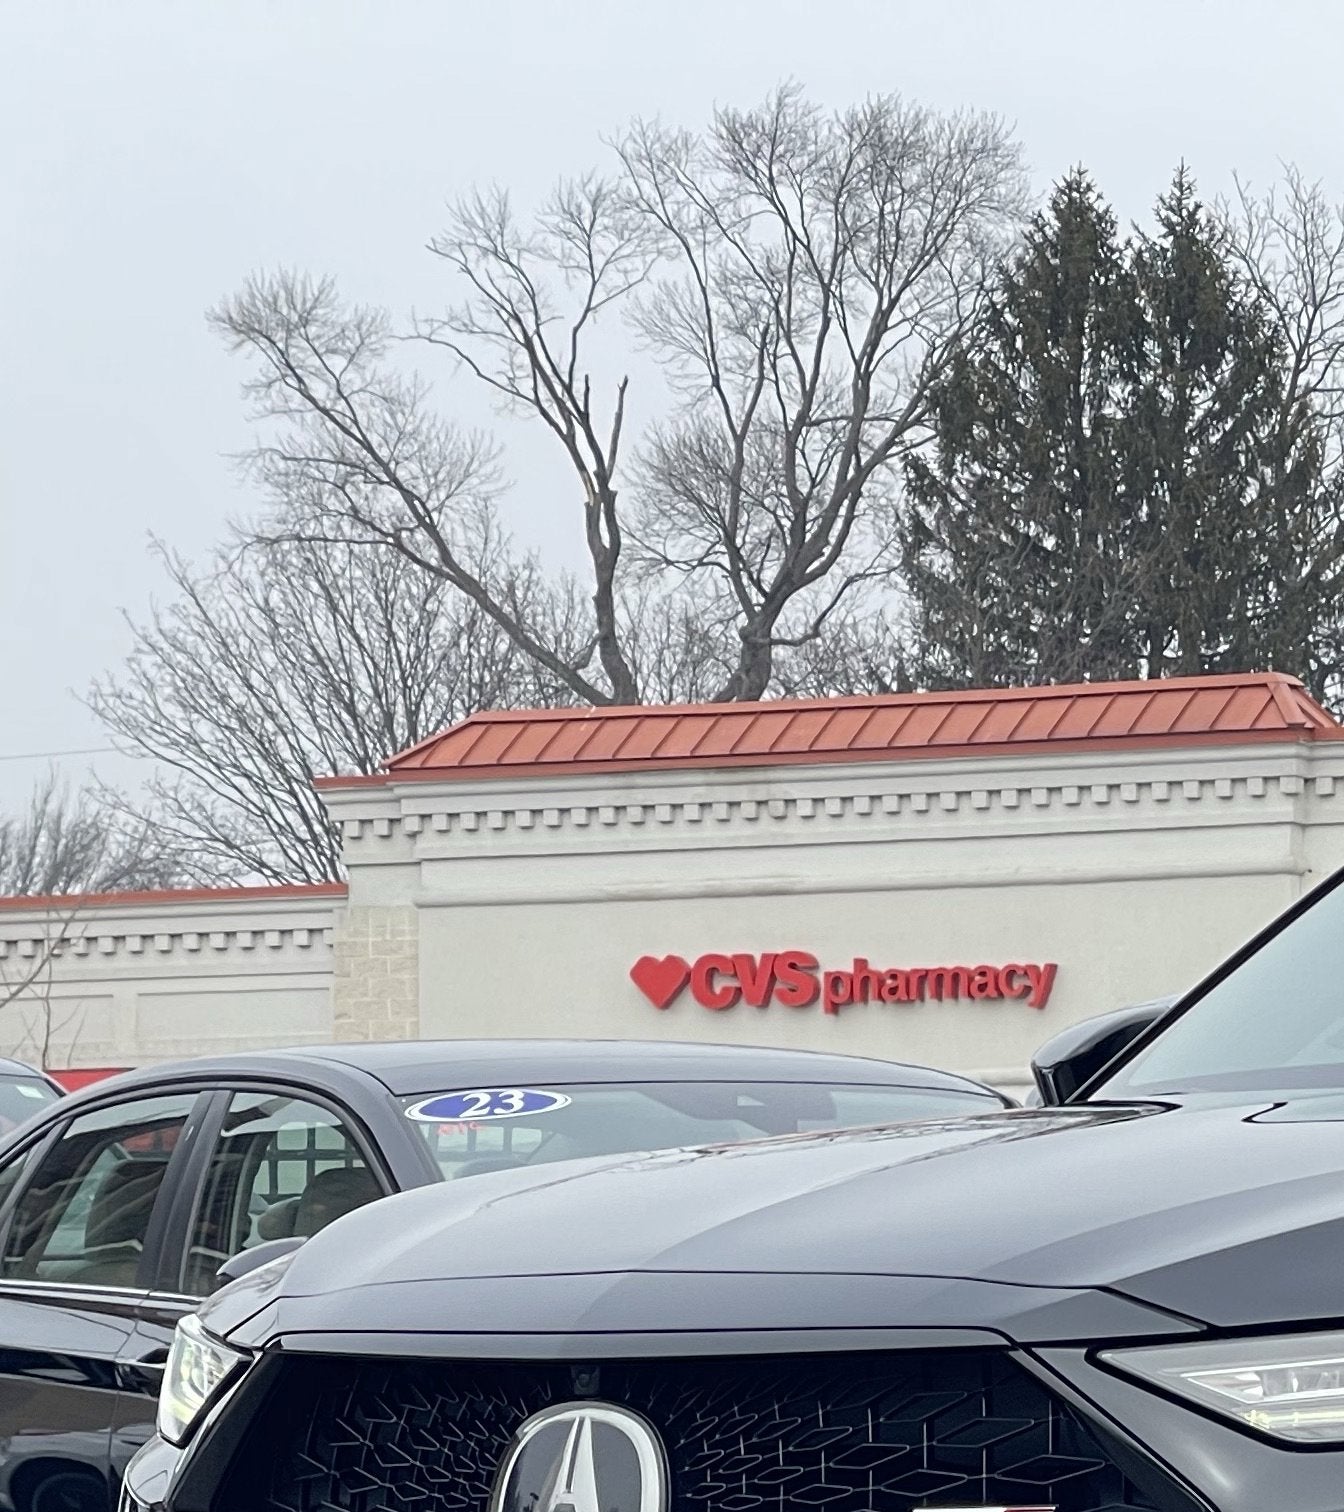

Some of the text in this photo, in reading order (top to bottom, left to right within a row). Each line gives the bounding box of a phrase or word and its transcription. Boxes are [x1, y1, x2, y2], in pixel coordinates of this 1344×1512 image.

[691, 951, 1058, 1014] CVS pharmacy
[458, 1089, 525, 1118] 23
